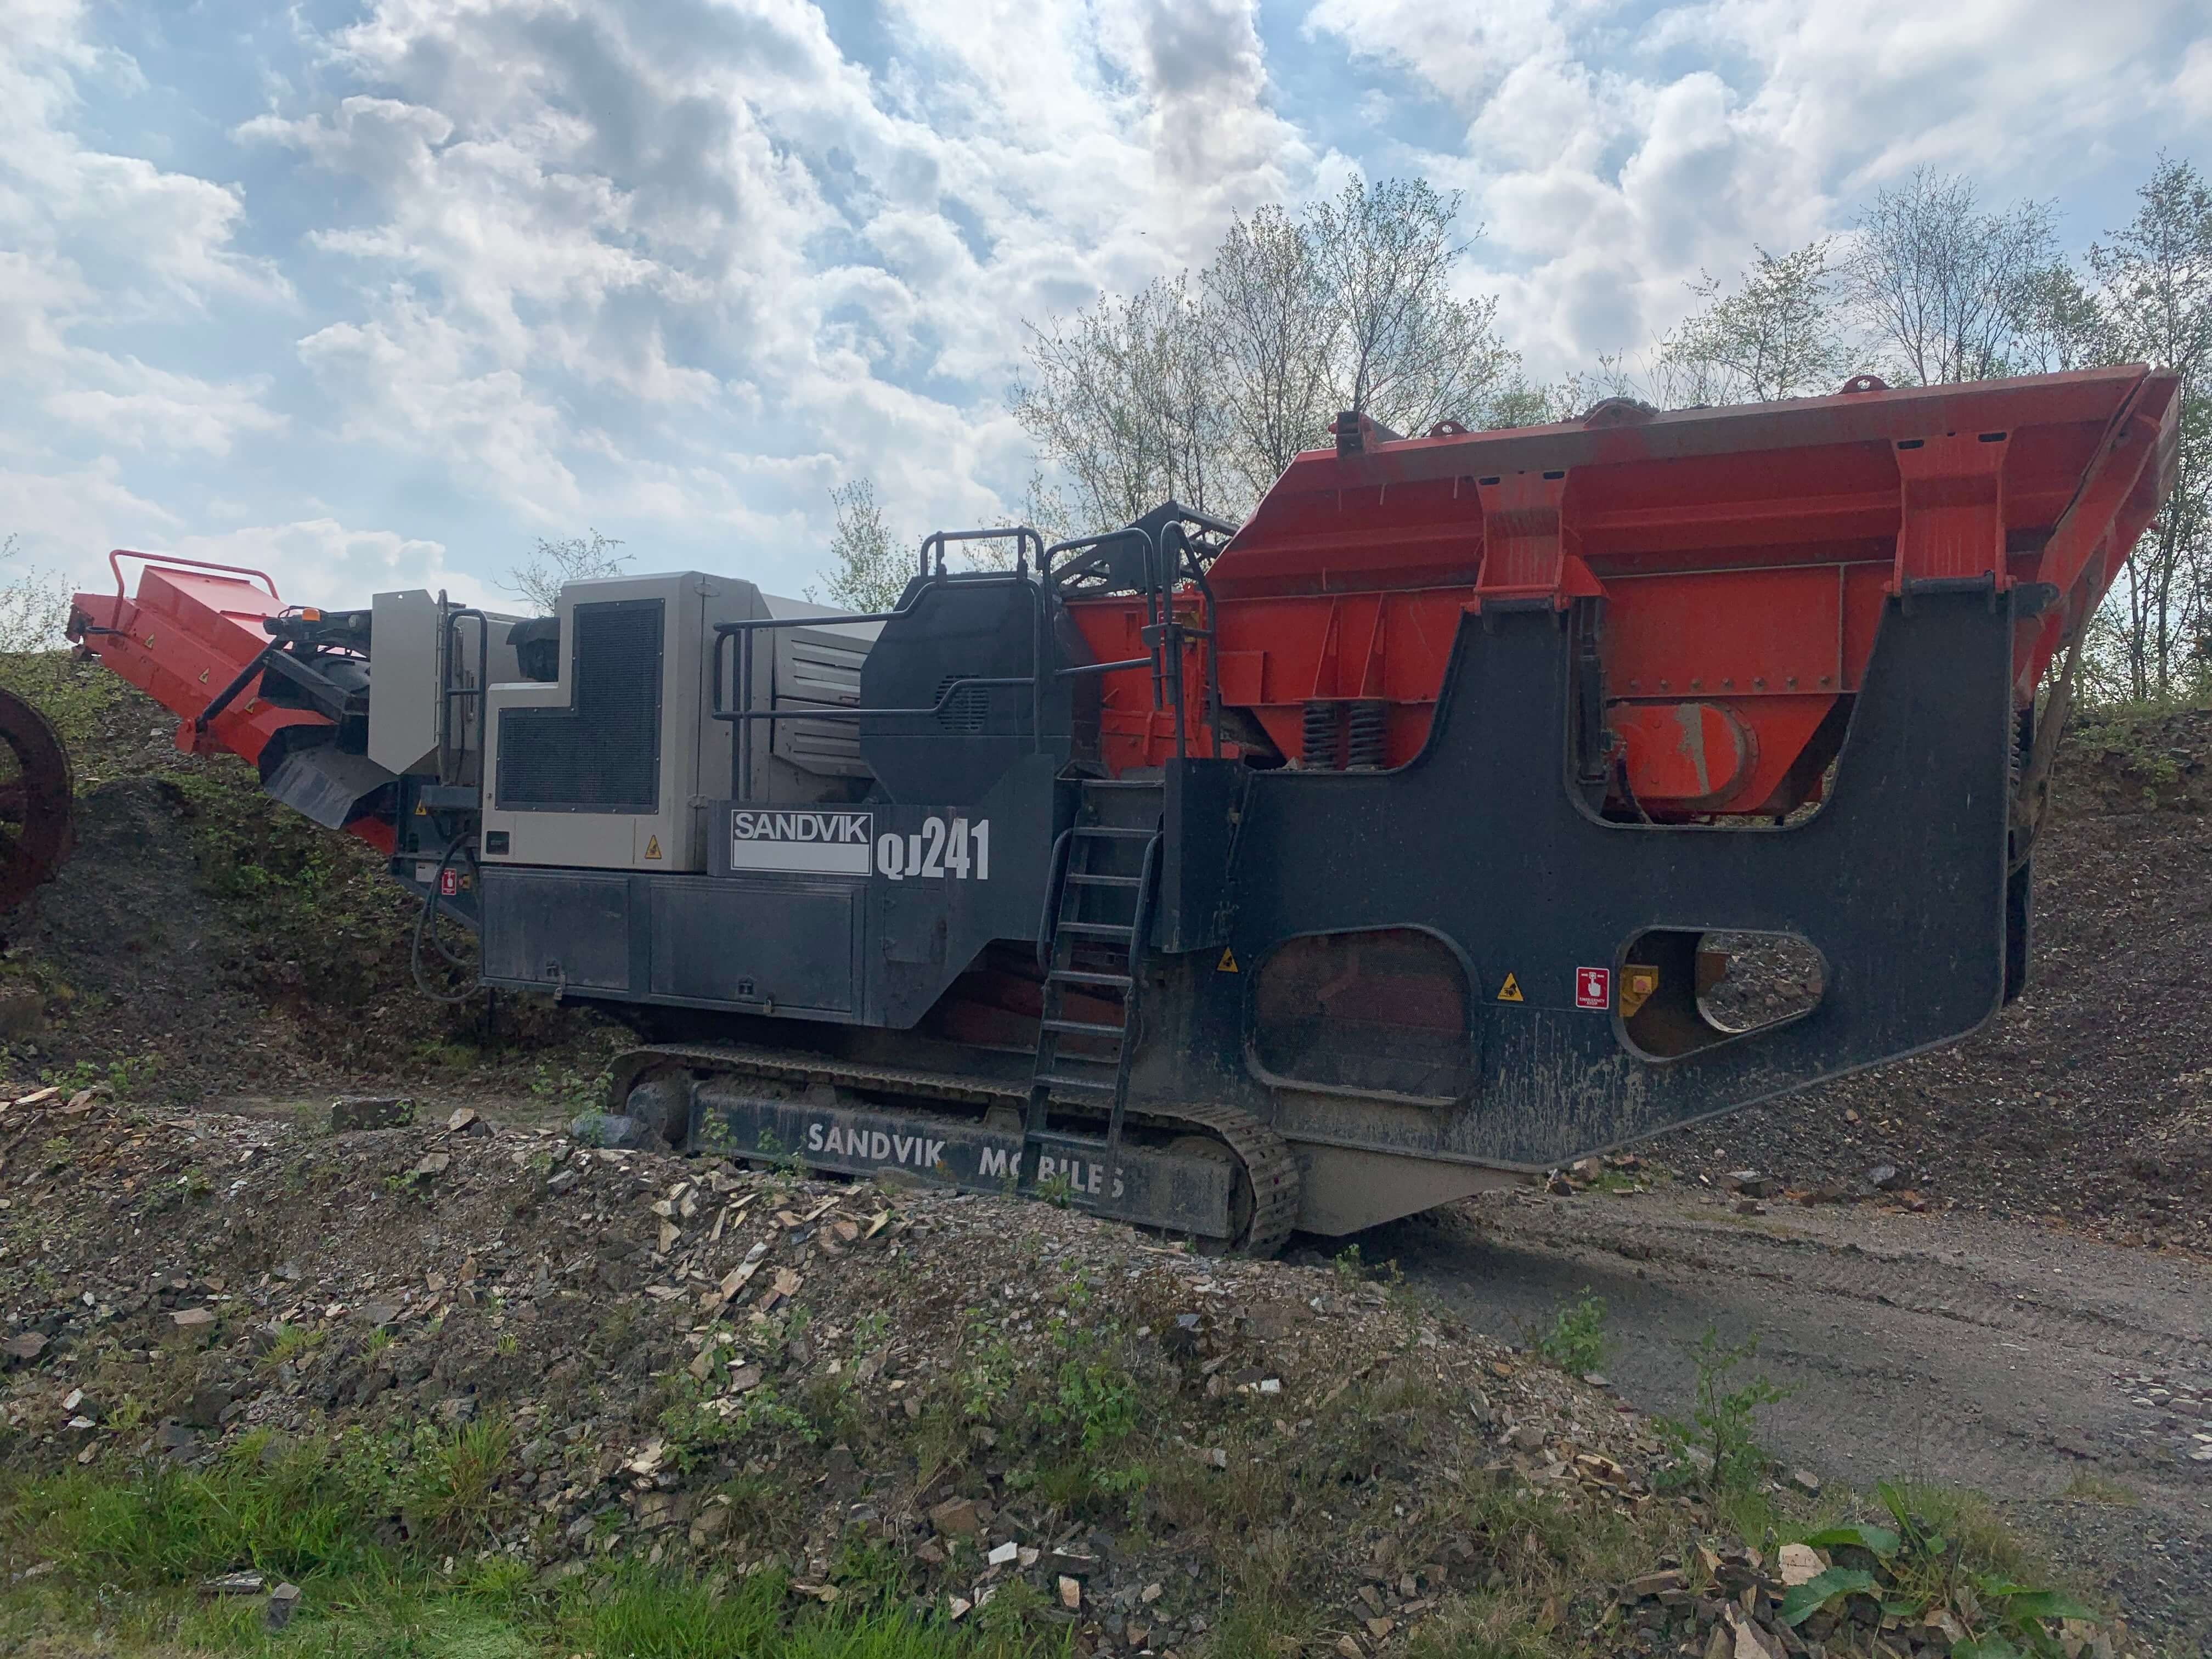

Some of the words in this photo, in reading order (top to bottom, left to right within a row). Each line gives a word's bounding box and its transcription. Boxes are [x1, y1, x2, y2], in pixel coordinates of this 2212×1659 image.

[735, 813, 868, 843] SANDVIK
[877, 817, 989, 880] QJ241
[808, 1123, 945, 1167] SANDVIK
